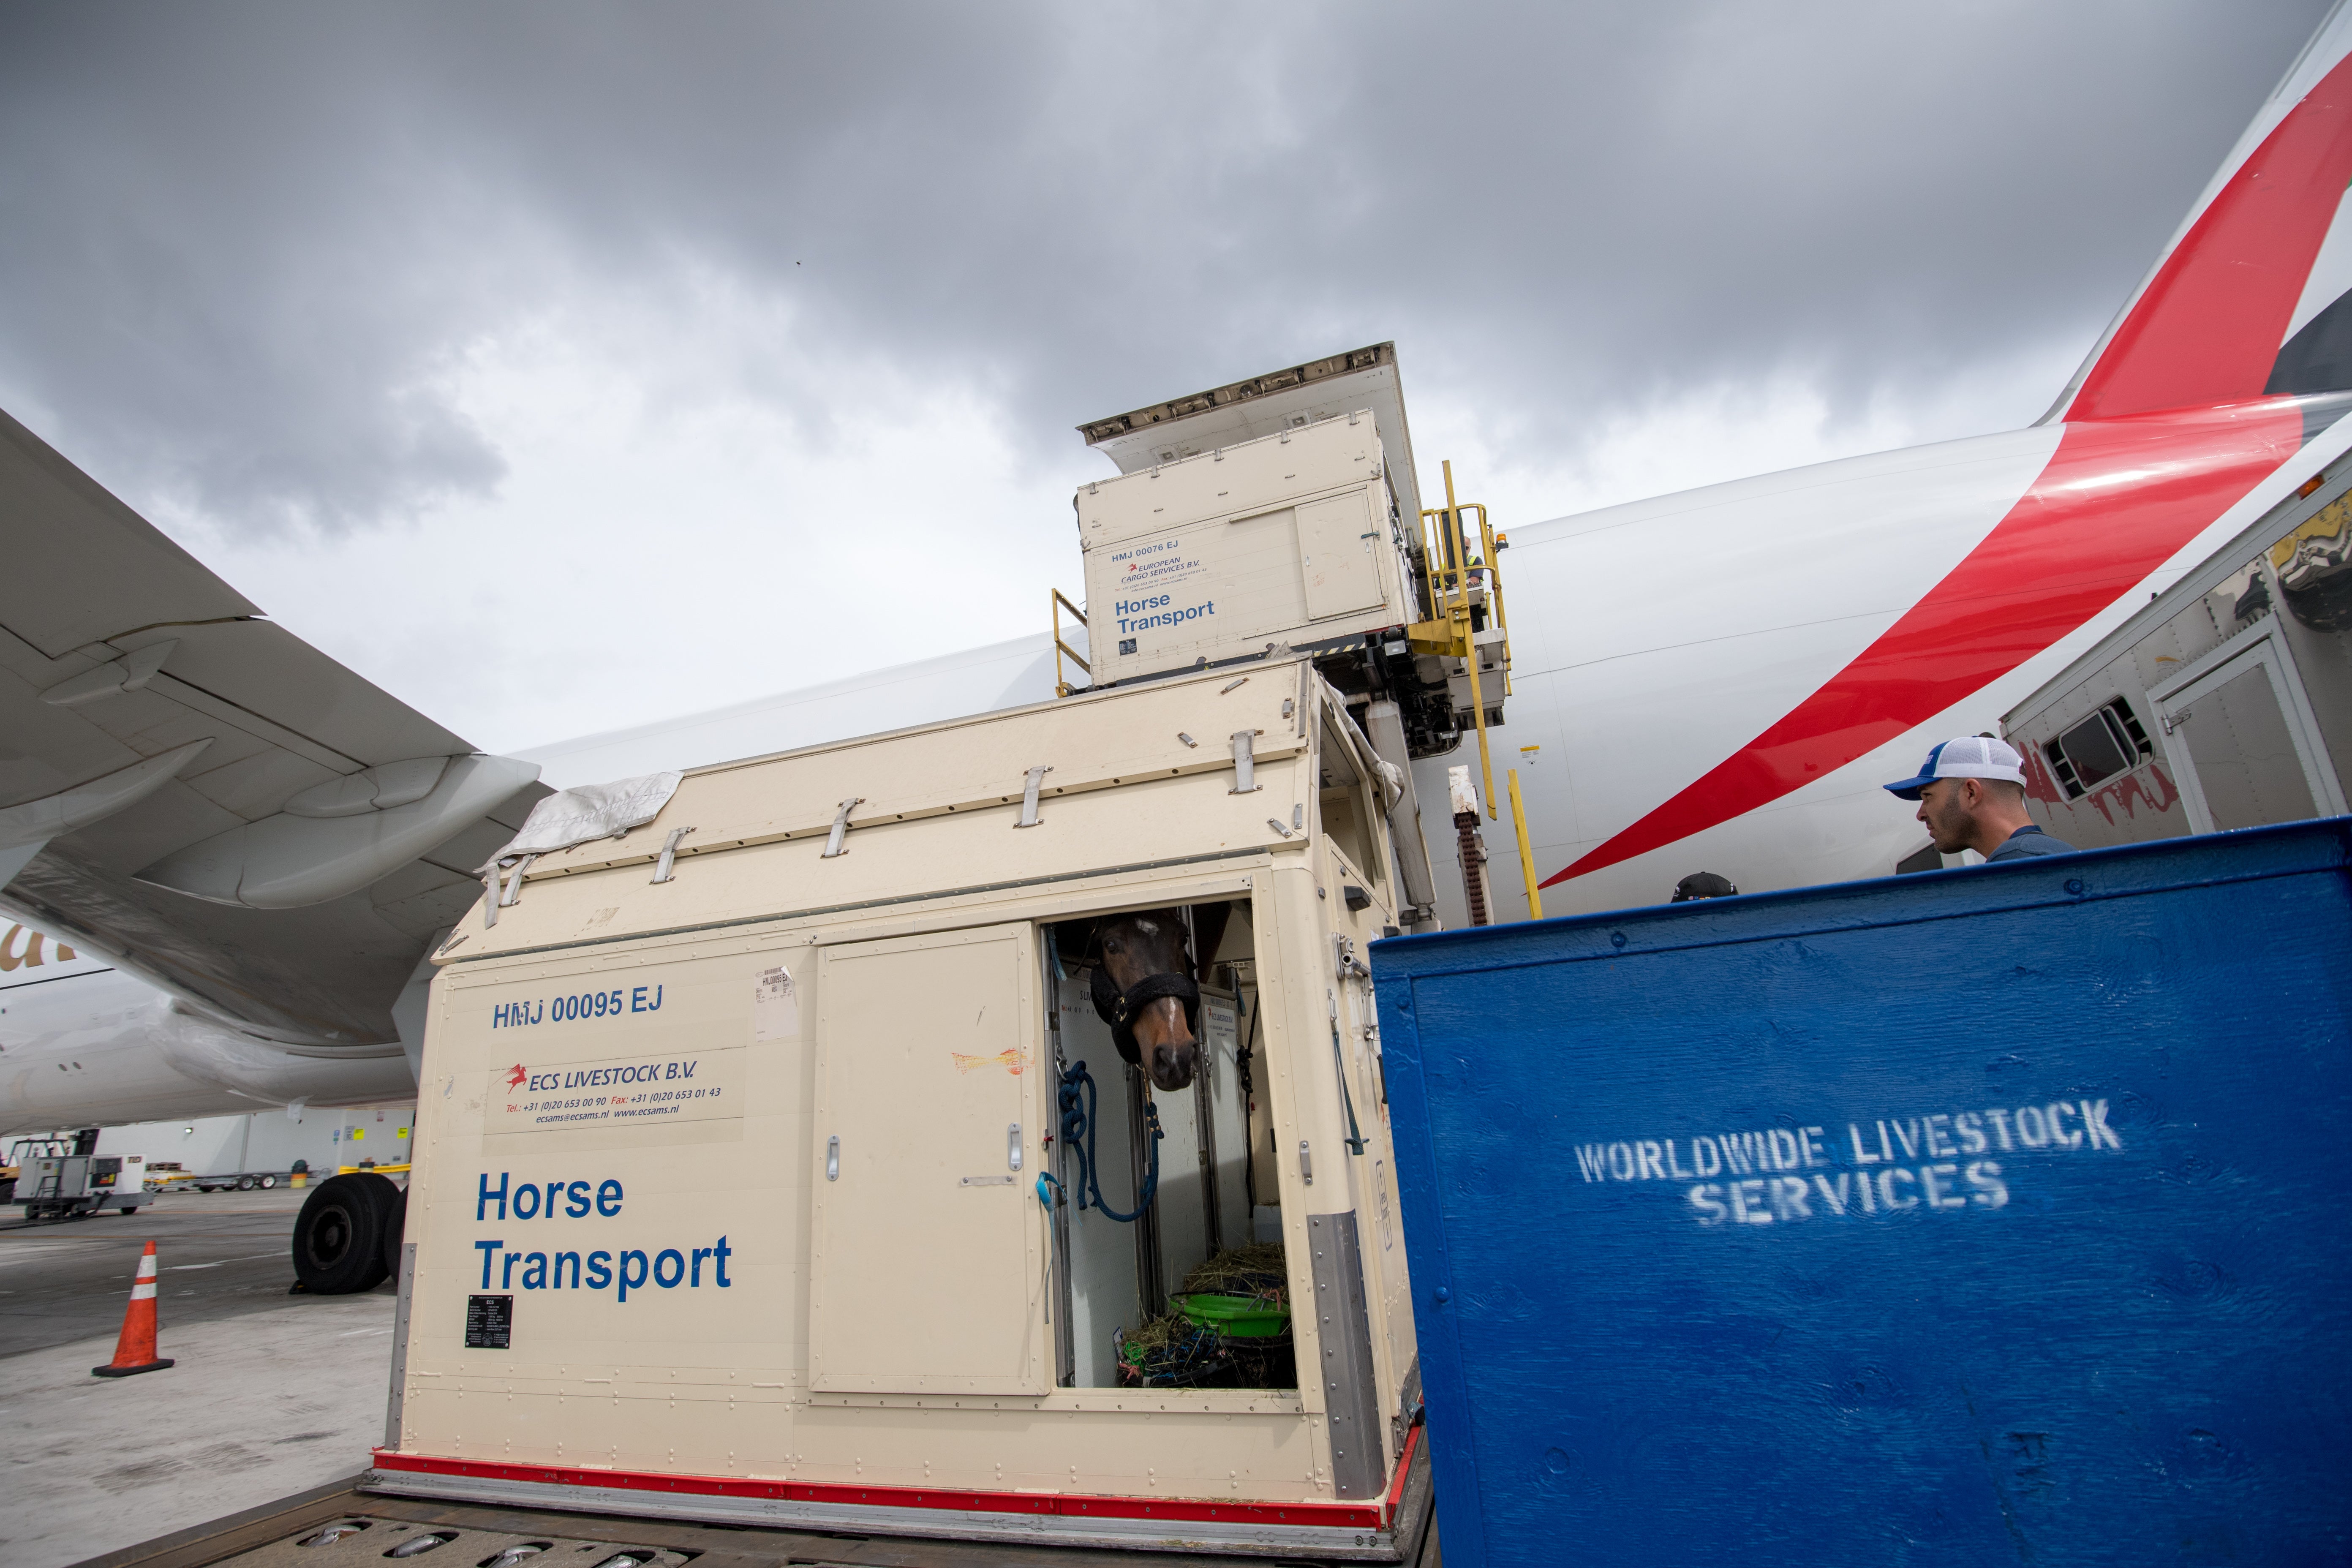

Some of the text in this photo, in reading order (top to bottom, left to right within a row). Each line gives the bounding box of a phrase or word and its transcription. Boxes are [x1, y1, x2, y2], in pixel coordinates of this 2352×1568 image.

[1112, 540, 1179, 562] HMJ 00076 EJ
[1138, 557, 1181, 572] EUROPEAN
[1121, 560, 1200, 583] CARGO SERVICES B.V.
[1115, 594, 1171, 616] Horse
[1117, 600, 1215, 634] Transport
[493, 985, 663, 1029] HMJ 00095 EJ
[529, 1061, 697, 1092] ECS LIVESTOCK B.V.
[506, 1088, 721, 1113] Tel.: +31 (0)20 653 00 90 Fax: +31 (0)20 653 01 43
[536, 1105, 680, 1123] ecsams@ecsams.nl www.ecsams.nl
[1574, 1099, 2120, 1184] WORLDWIDE LIVESTOCK
[476, 1172, 623, 1221] Horse
[1690, 1161, 2010, 1226] SERVICES
[474, 1234, 732, 1303] Transport
